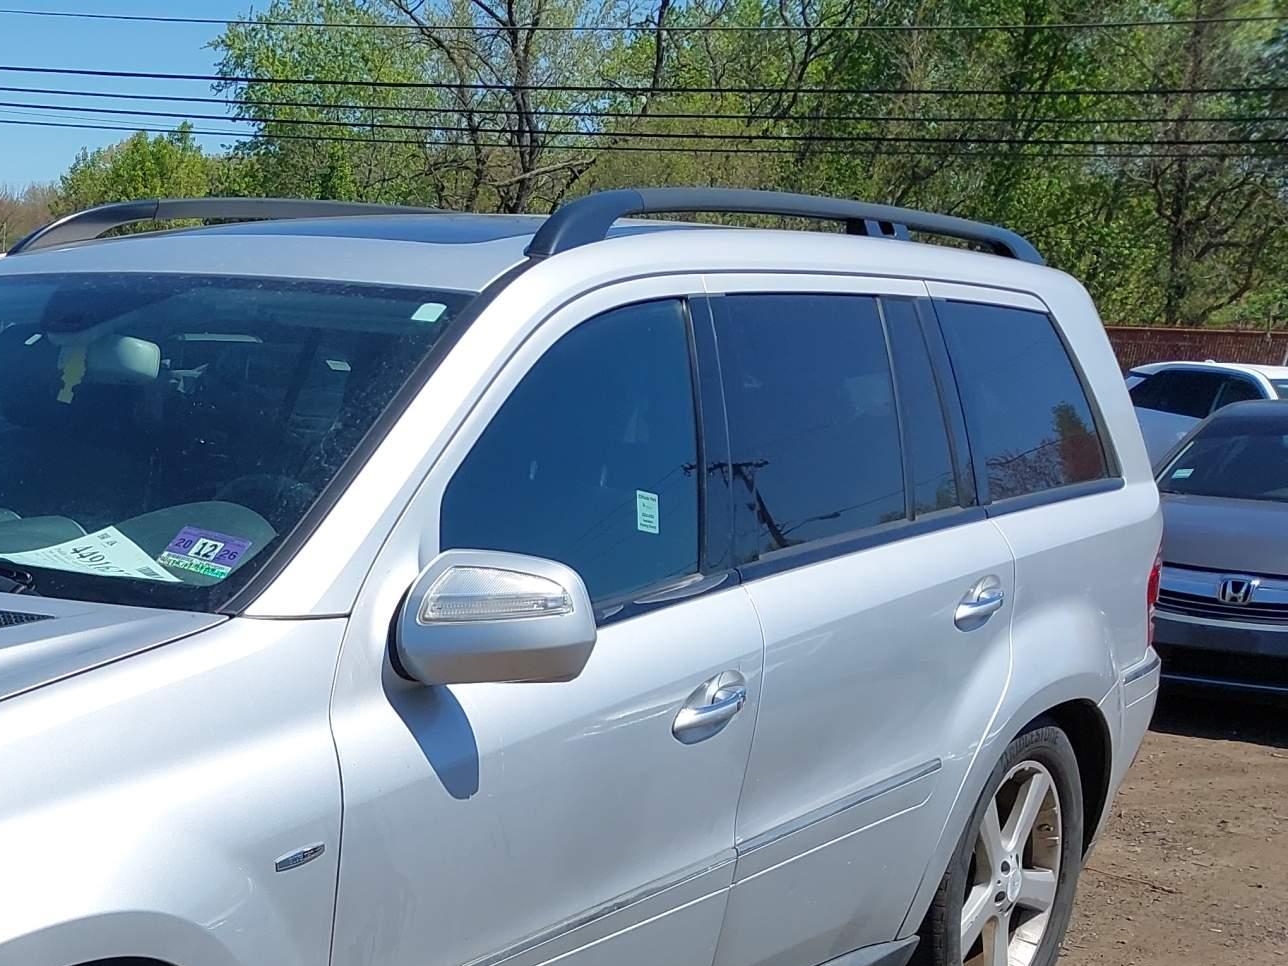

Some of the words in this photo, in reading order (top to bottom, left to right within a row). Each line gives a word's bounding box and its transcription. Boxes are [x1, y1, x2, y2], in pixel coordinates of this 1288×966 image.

[174, 537, 193, 550] 20
[194, 541, 218, 558] 12
[219, 549, 239, 561] 26
